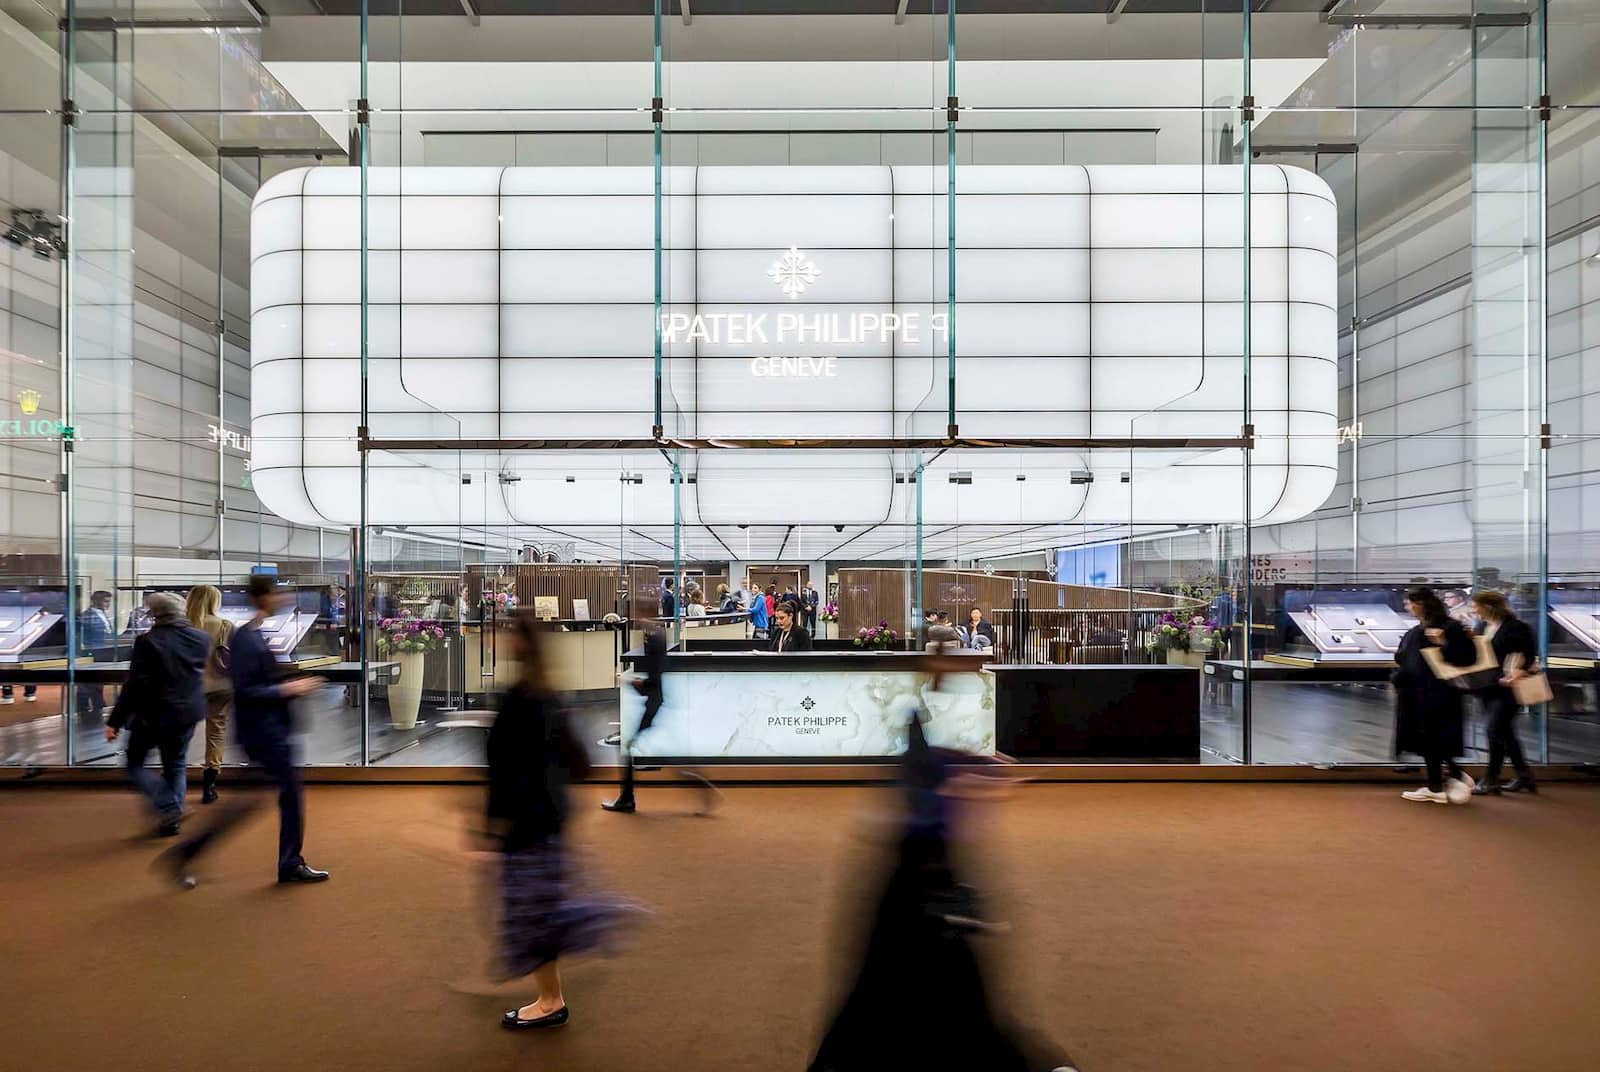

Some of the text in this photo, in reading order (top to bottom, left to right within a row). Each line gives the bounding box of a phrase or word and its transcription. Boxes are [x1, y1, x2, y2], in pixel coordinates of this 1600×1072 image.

[670, 311, 769, 344] PATEK
[776, 311, 921, 344] PHILIPPE
[751, 356, 839, 377] GENEVE
[767, 716, 848, 727] PATEK PHILIPPE
[795, 727, 821, 735] GENEVE
